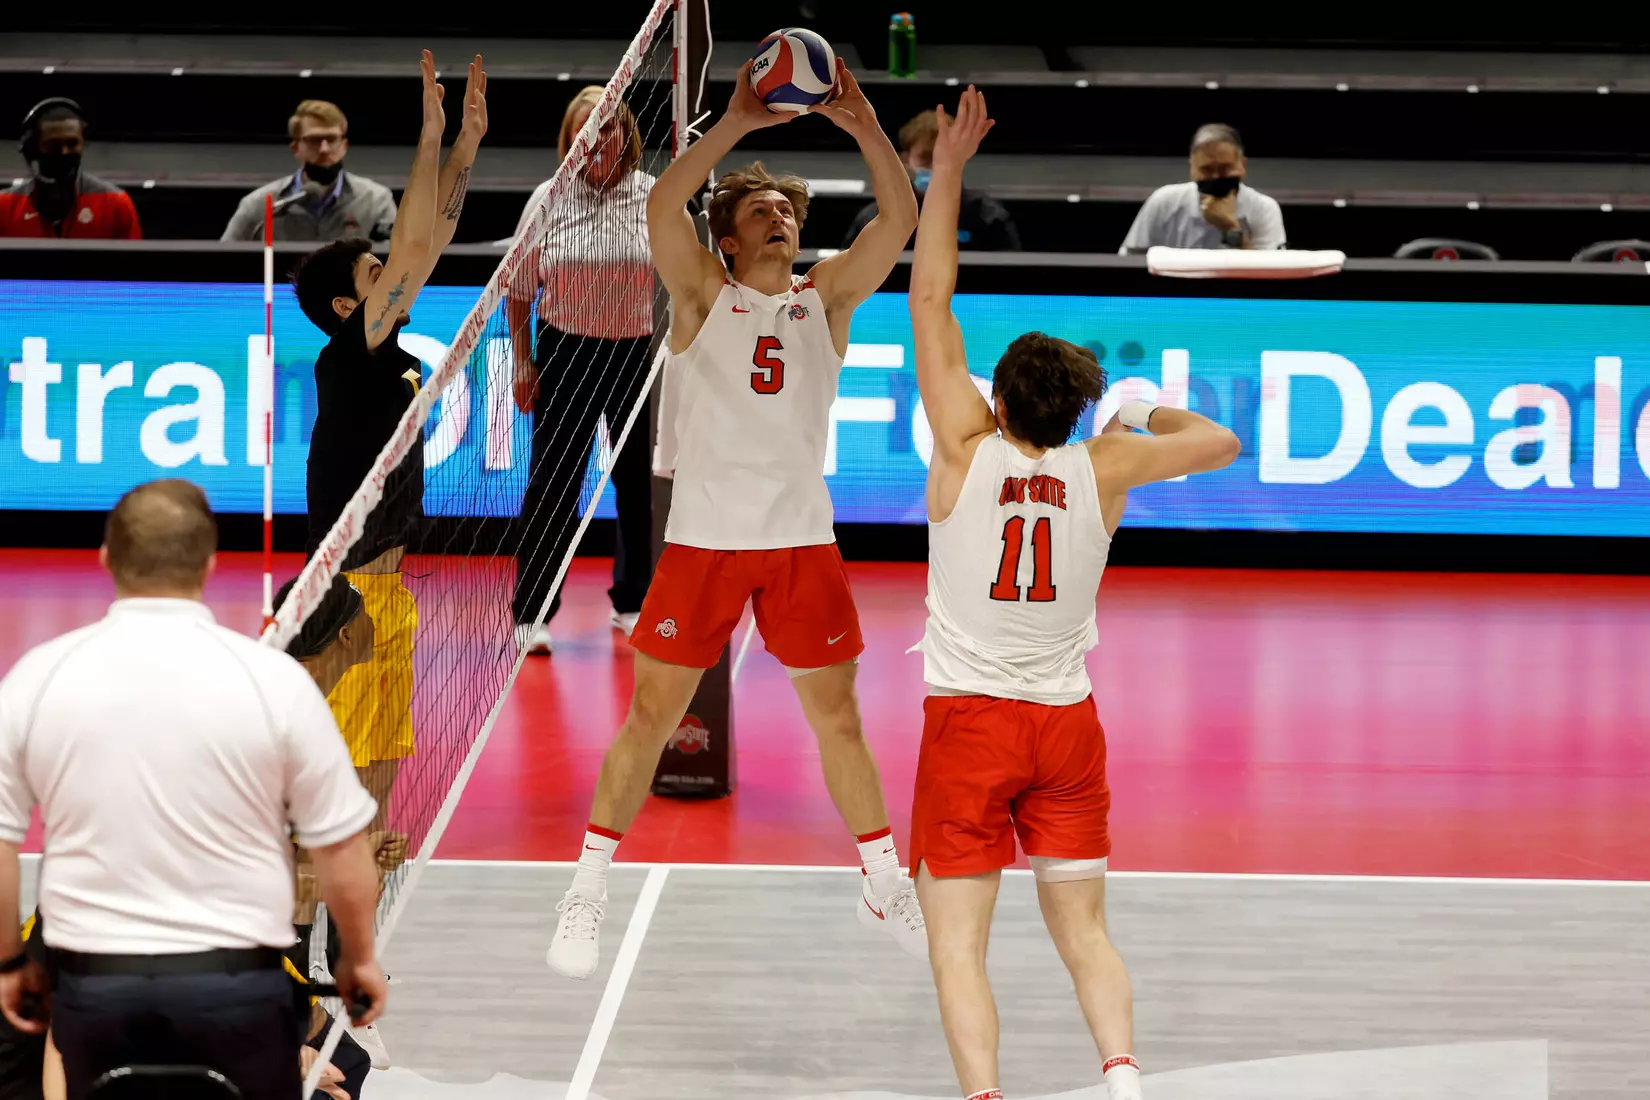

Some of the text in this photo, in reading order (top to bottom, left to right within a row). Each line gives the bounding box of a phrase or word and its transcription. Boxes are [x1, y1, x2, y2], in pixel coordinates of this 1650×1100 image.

[751, 335, 784, 395] 5
[1259, 350, 1650, 490] Deal
[989, 515, 1056, 602] 11
